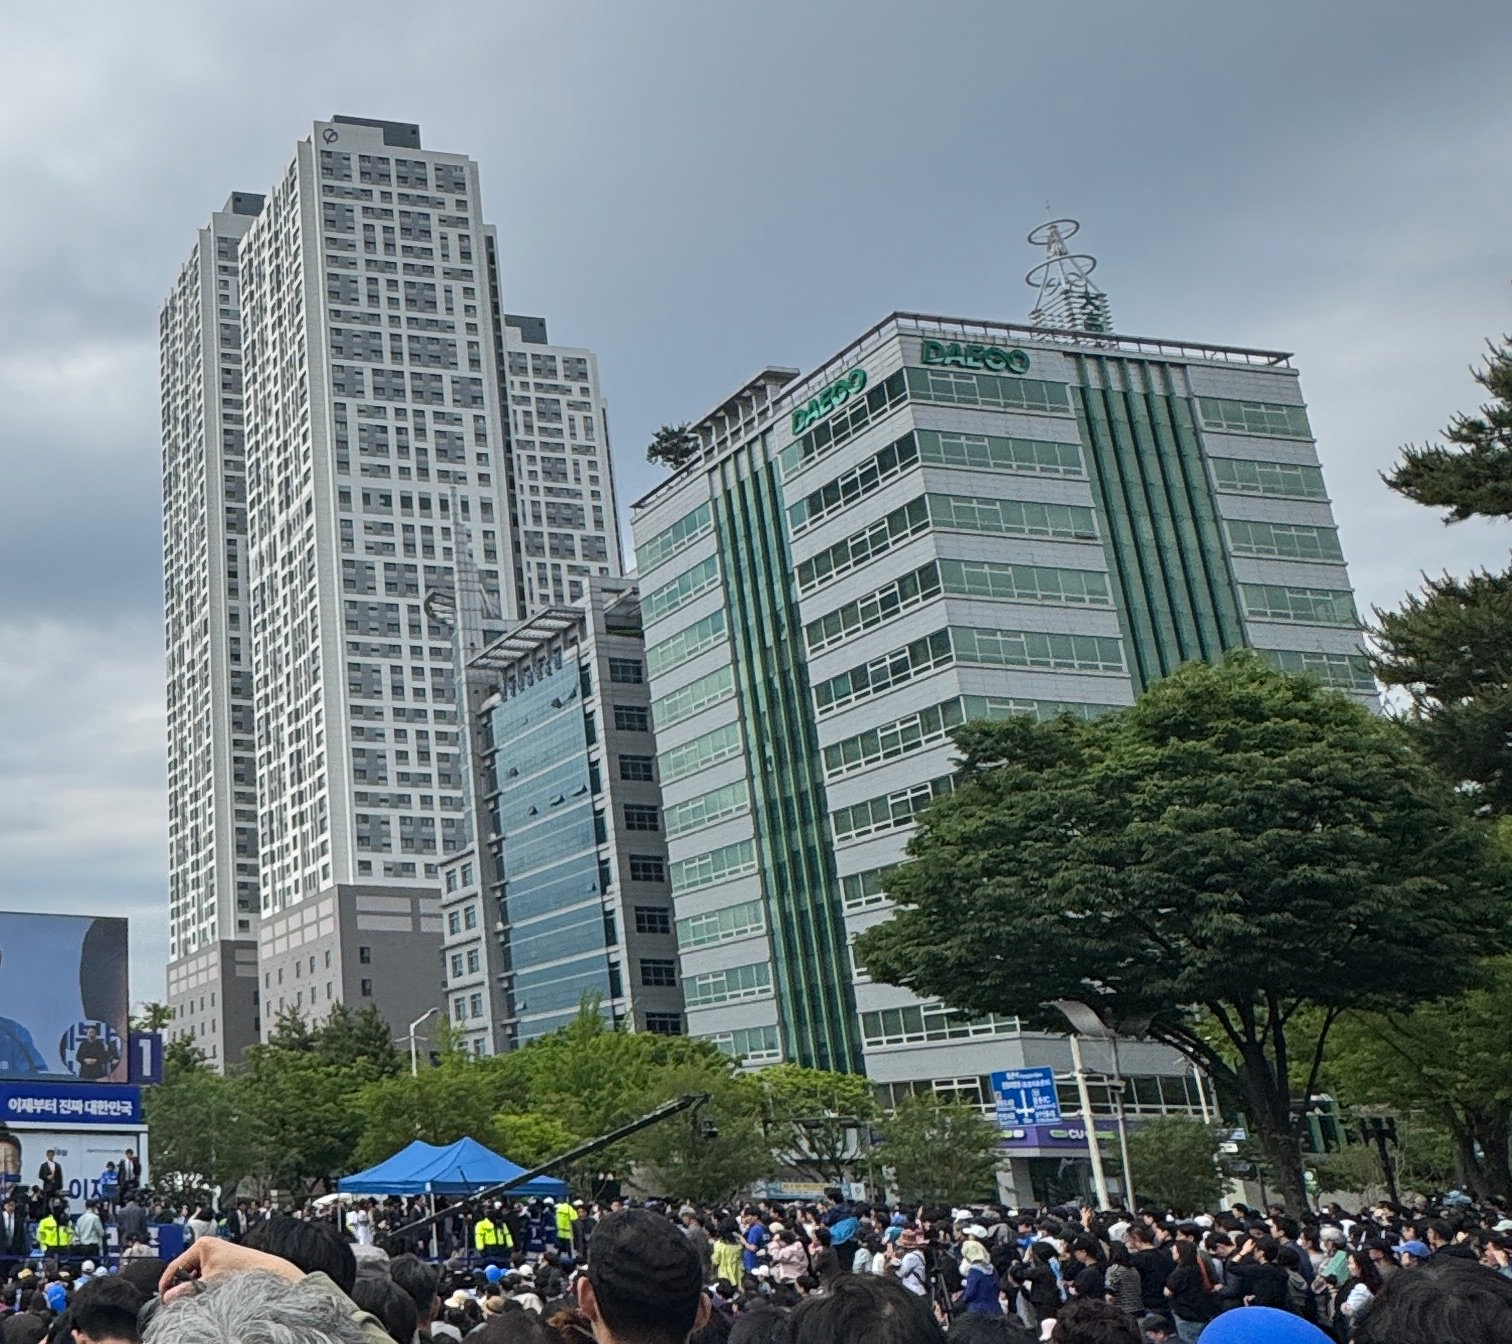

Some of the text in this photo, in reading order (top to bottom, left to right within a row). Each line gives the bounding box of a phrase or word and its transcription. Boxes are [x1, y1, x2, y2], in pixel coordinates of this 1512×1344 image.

[138, 1038, 152, 1077] 1
[8, 1097, 133, 1116] 이제부터 진짜 대한민국
